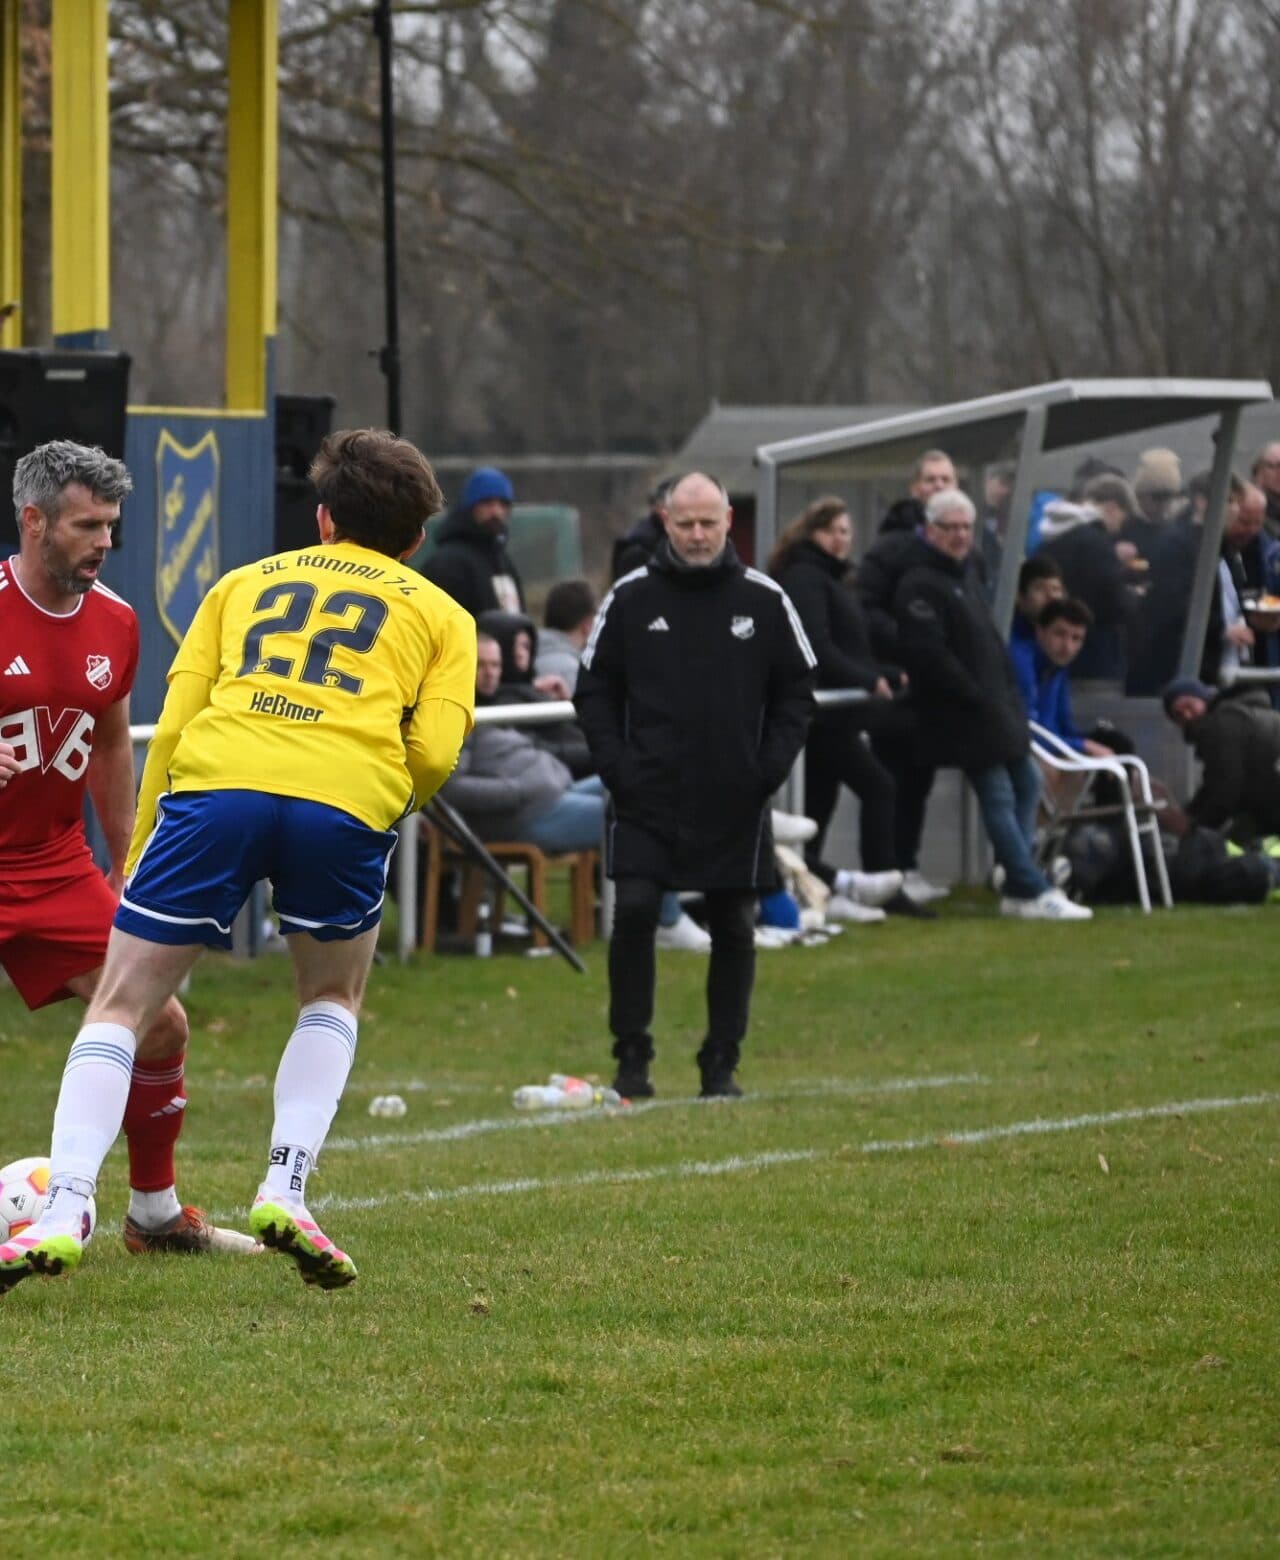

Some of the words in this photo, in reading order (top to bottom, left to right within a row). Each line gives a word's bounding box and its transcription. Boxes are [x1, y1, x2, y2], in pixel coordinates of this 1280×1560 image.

[261, 558, 288, 575] SC
[235, 580, 390, 696] 22
[248, 691, 325, 722] Heßmer
